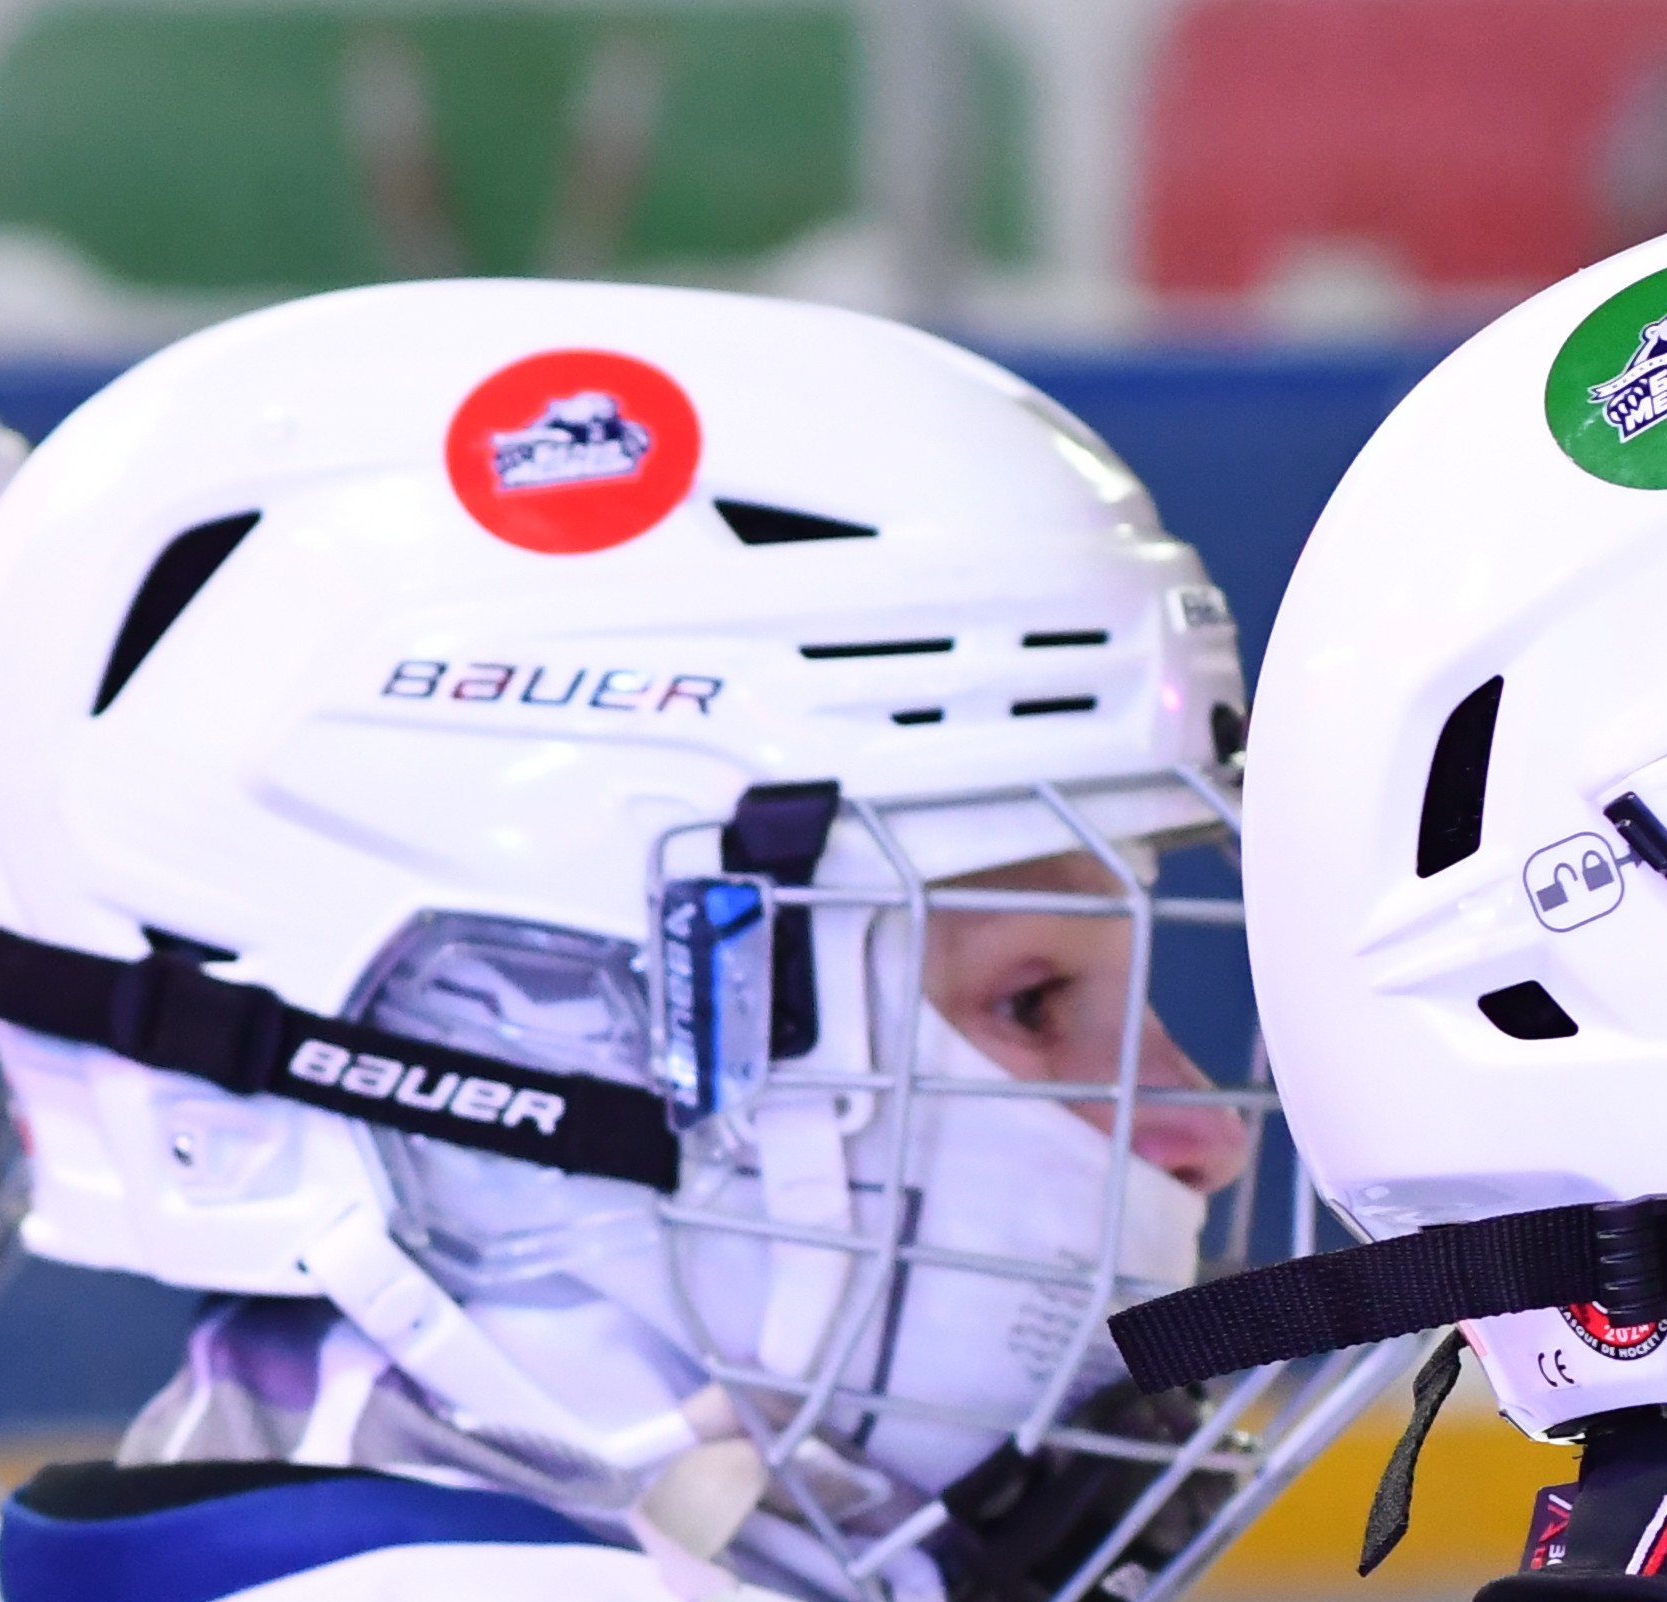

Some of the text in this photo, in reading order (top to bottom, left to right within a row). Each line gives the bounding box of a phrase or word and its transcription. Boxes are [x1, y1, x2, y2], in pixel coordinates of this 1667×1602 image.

[381, 660, 724, 715] BAUER
[289, 1038, 565, 1135] BAUER
[1559, 1306, 1599, 1348] ASQUE
